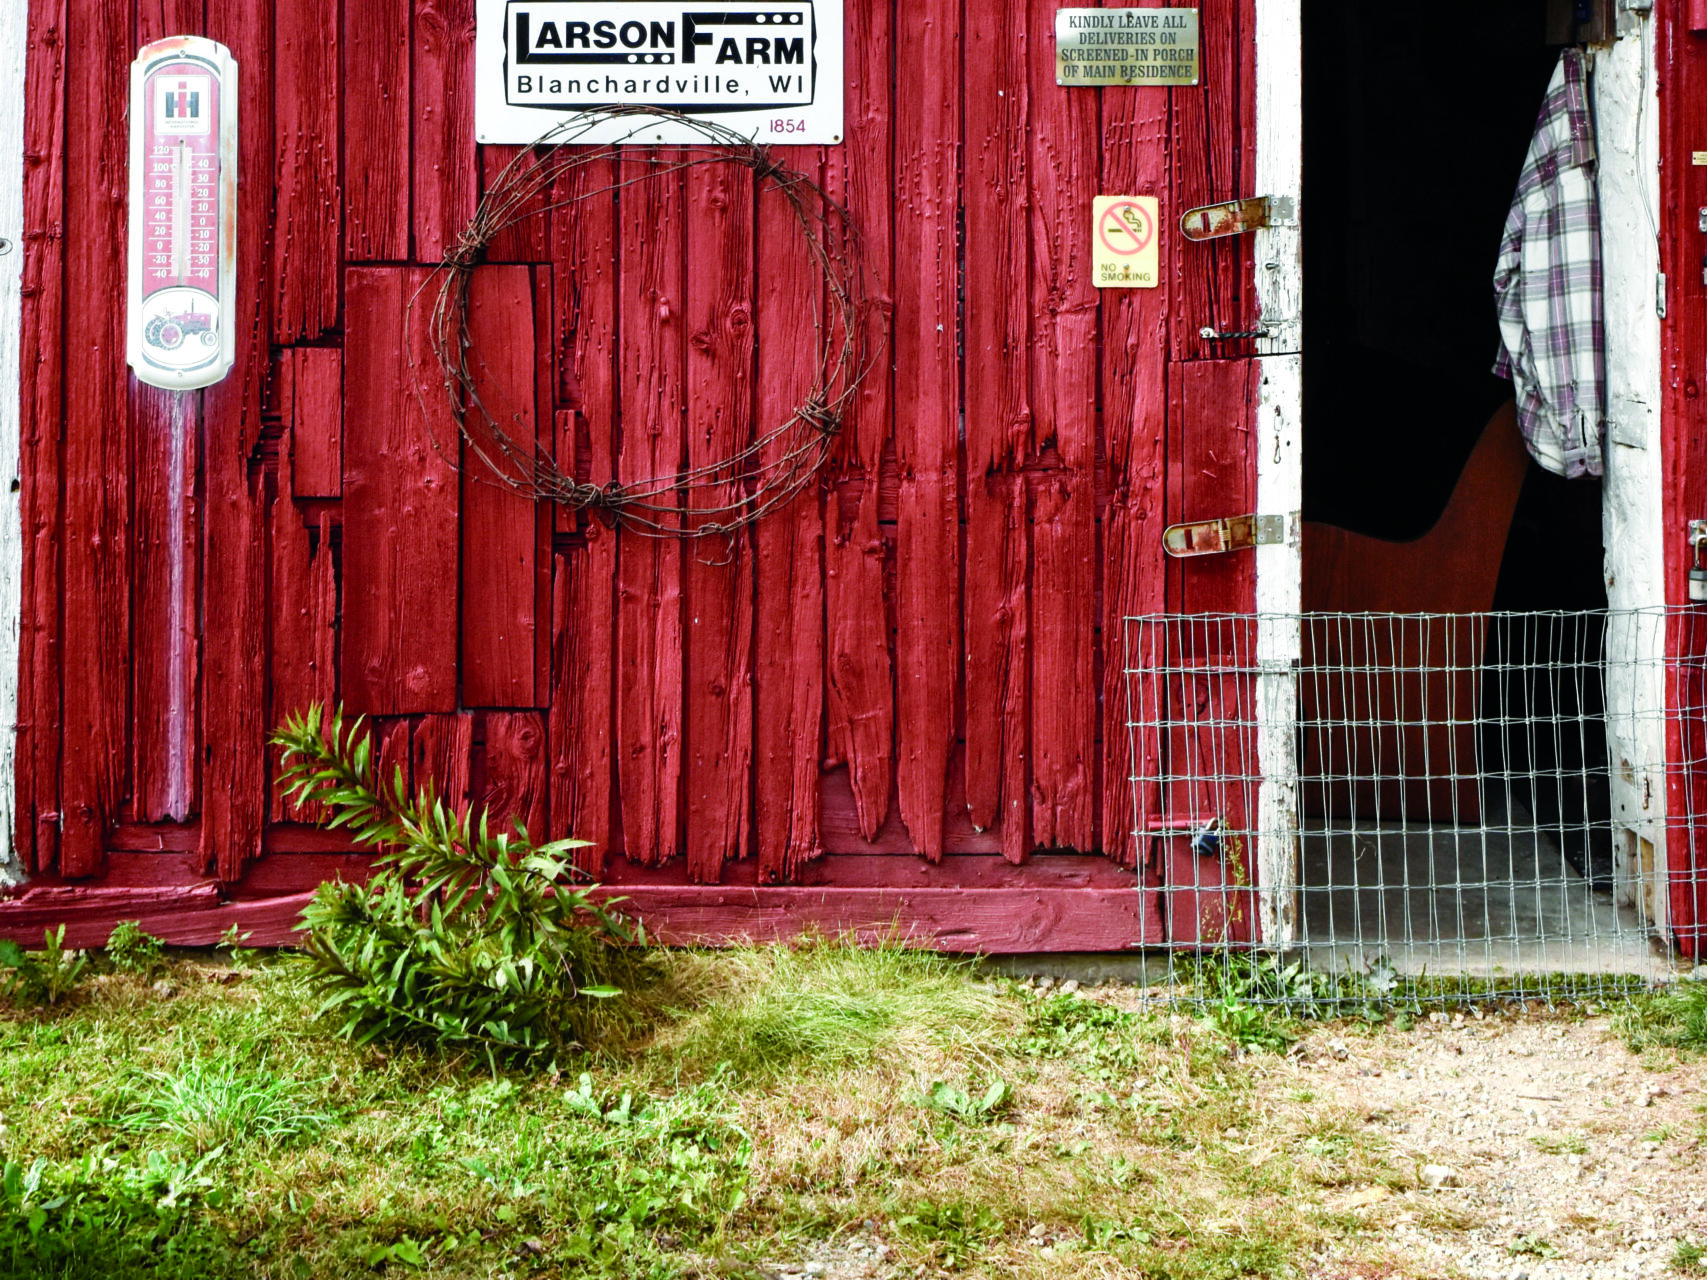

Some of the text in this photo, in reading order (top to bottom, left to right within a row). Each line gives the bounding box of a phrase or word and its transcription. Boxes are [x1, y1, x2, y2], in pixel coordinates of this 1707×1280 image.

[1069, 15, 1187, 28] KINDLY LEAVE ALL
[516, 12, 804, 65] LARSON FARM
[1079, 32, 1177, 45] DELIVERIES ON
[1061, 48, 1194, 61] SCREENED-IN PORCH
[1063, 65, 1193, 78] OF MAIN RESIDENCE
[517, 75, 803, 96] Blanchardville, WI
[769, 119, 806, 133] 1854
[153, 145, 170, 155] 120
[153, 163, 169, 172] 100
[198, 159, 209, 168] 40
[197, 174, 209, 182] 30
[155, 180, 166, 188] 80
[198, 188, 209, 197] 20
[155, 196, 166, 204] 60
[198, 202, 209, 211] 10
[155, 211, 166, 220] 40
[199, 217, 206, 225] 0
[154, 227, 166, 235] 20
[157, 241, 163, 249] 0
[1101, 263, 1117, 272] NO
[1101, 272, 1151, 281] SMOKING
